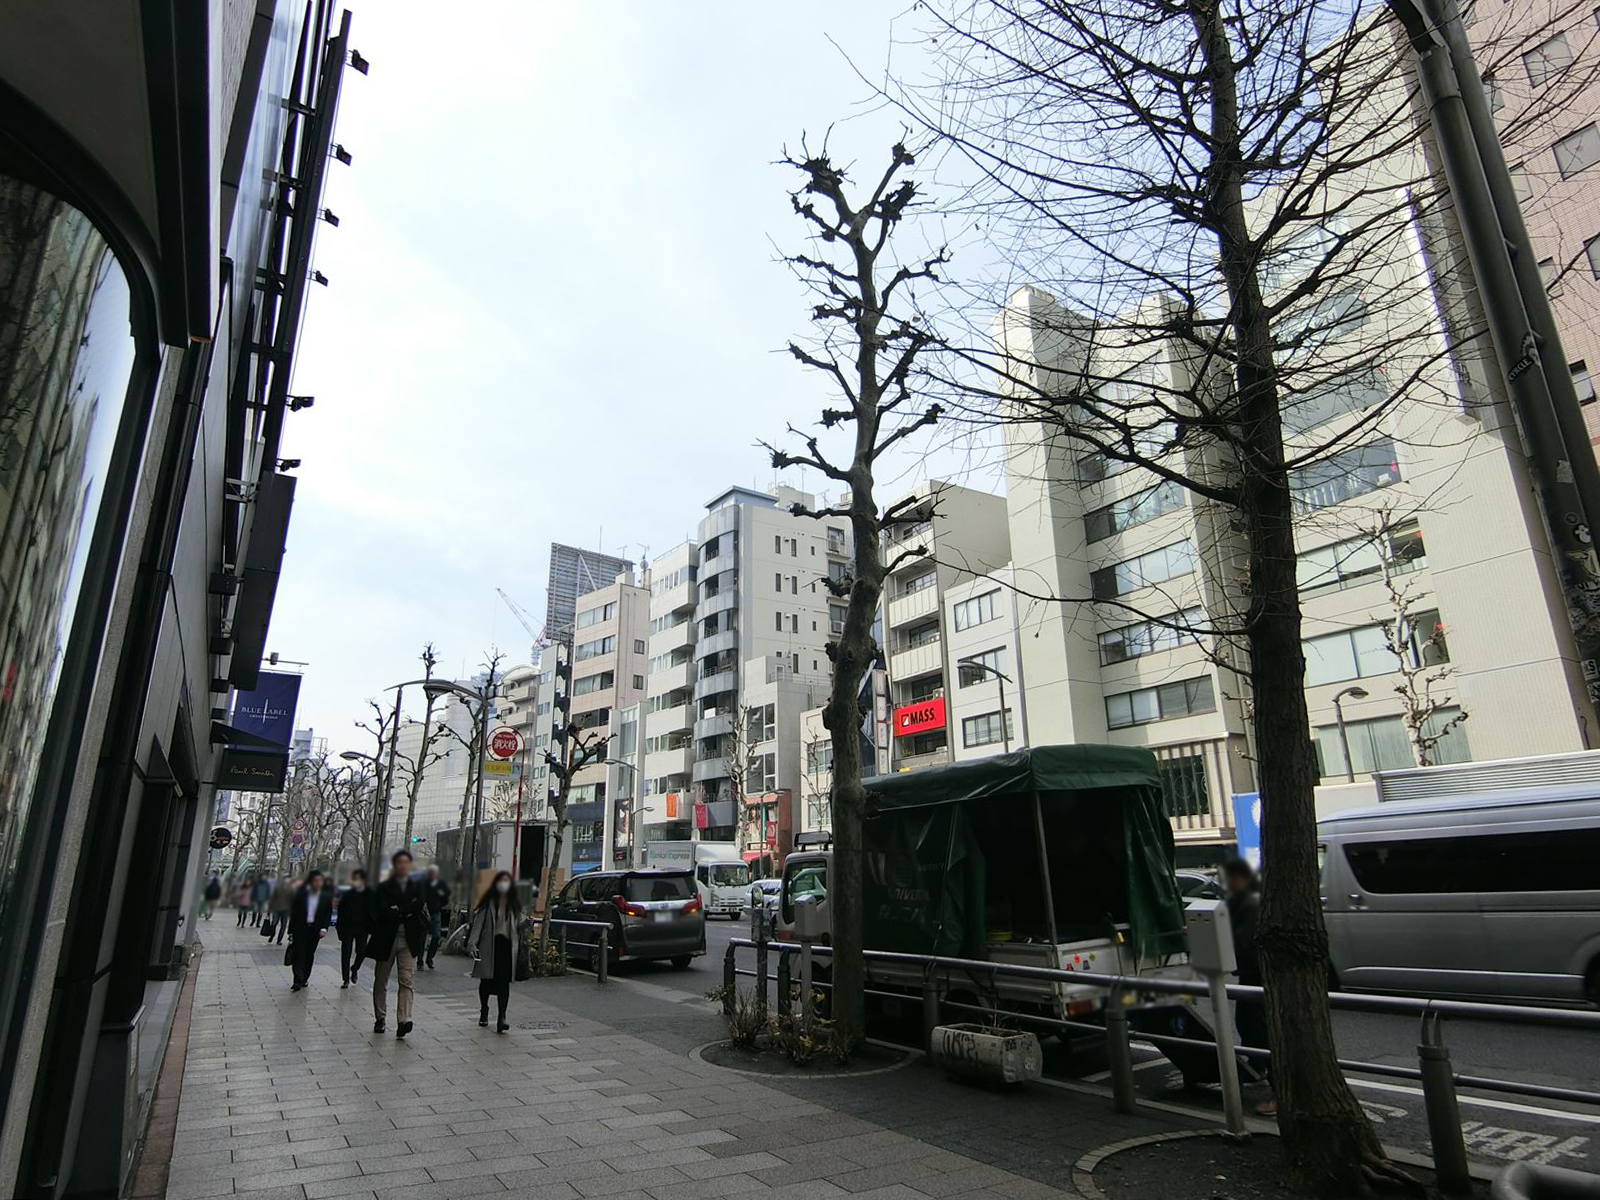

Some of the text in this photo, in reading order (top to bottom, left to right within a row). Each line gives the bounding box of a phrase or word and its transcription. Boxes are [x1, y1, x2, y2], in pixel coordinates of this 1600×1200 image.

[241, 706, 263, 714] BLUE
[910, 707, 935, 726] MASS
[493, 738, 516, 750] 消火栓
[230, 765, 275, 777] Paul Smith
